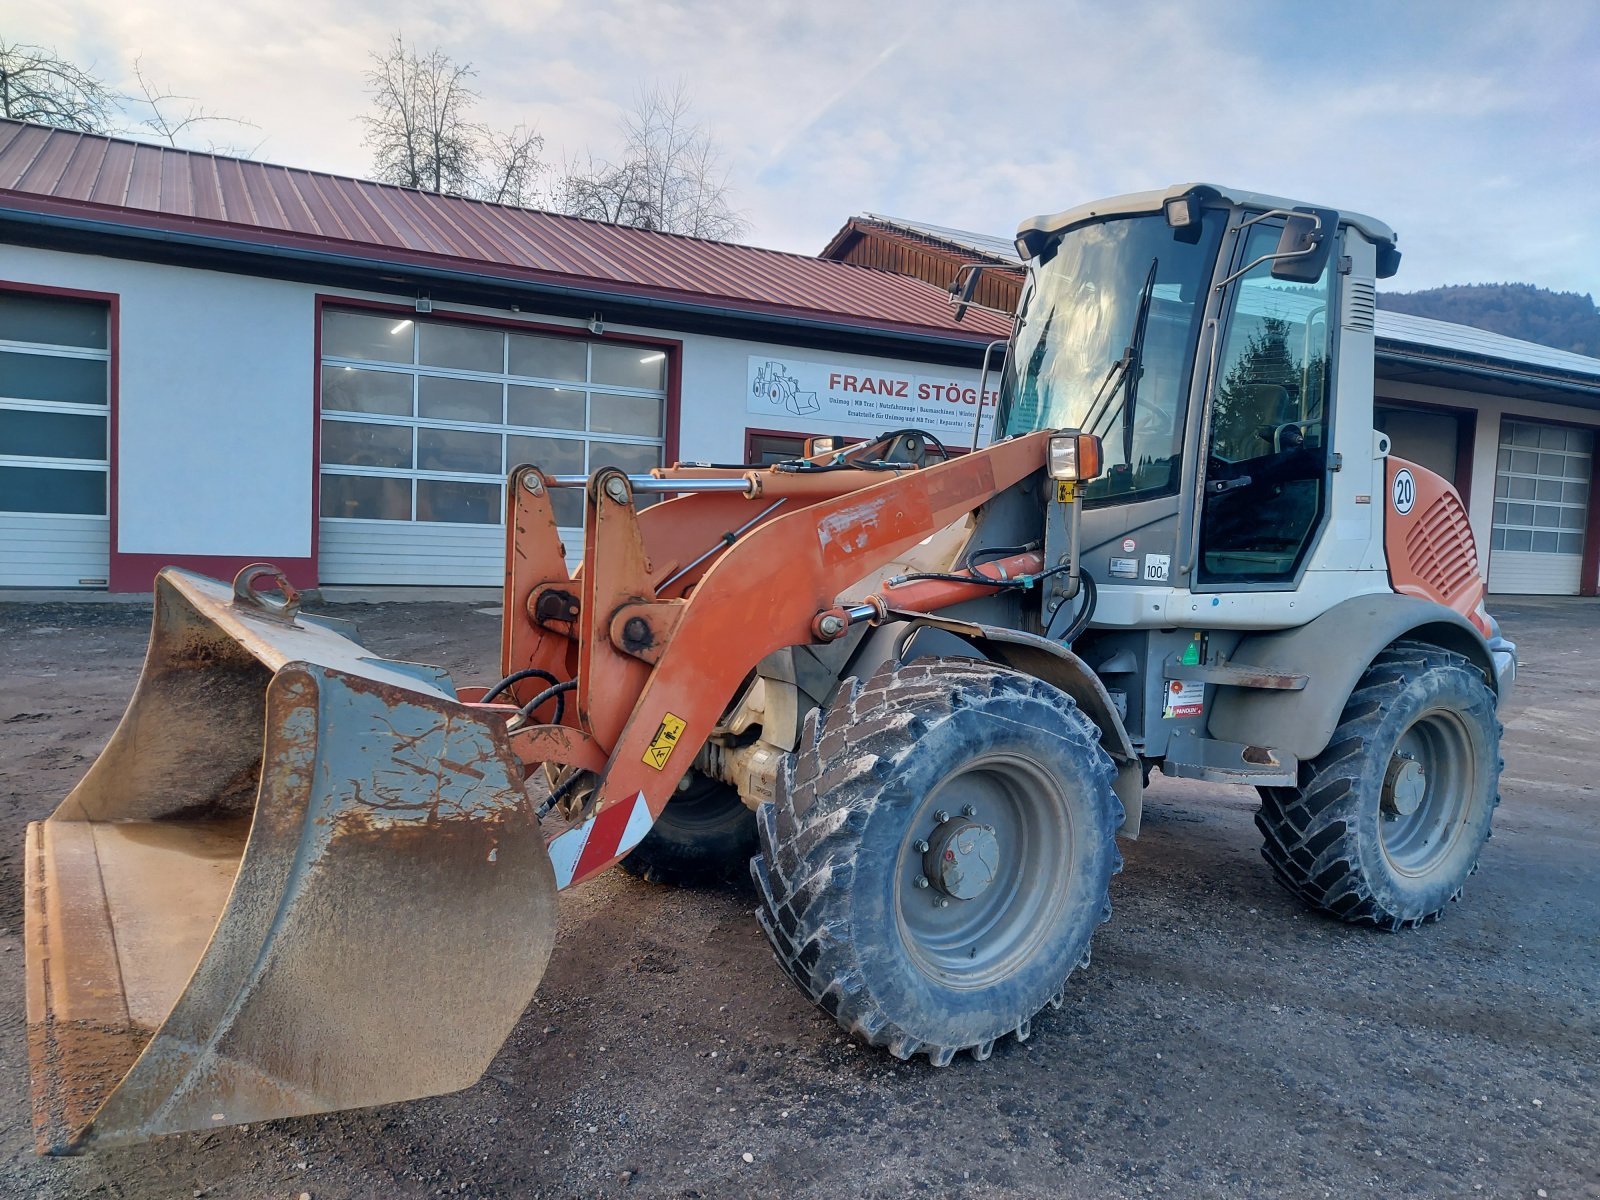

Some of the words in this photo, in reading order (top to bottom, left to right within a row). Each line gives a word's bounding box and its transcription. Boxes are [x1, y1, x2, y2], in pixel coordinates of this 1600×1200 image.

[829, 373, 908, 398] FRANZ
[829, 397, 849, 406] Unimog
[879, 402, 915, 412] Nutzfahrzeuge
[920, 406, 955, 416] Baumaschinen
[847, 410, 875, 419] Ersatzteile
[885, 413, 904, 422] Unimog
[940, 419, 963, 428] Reparatur
[967, 421, 984, 429] Serce
[1396, 479, 1411, 504] 20
[1147, 565, 1162, 578] 100
